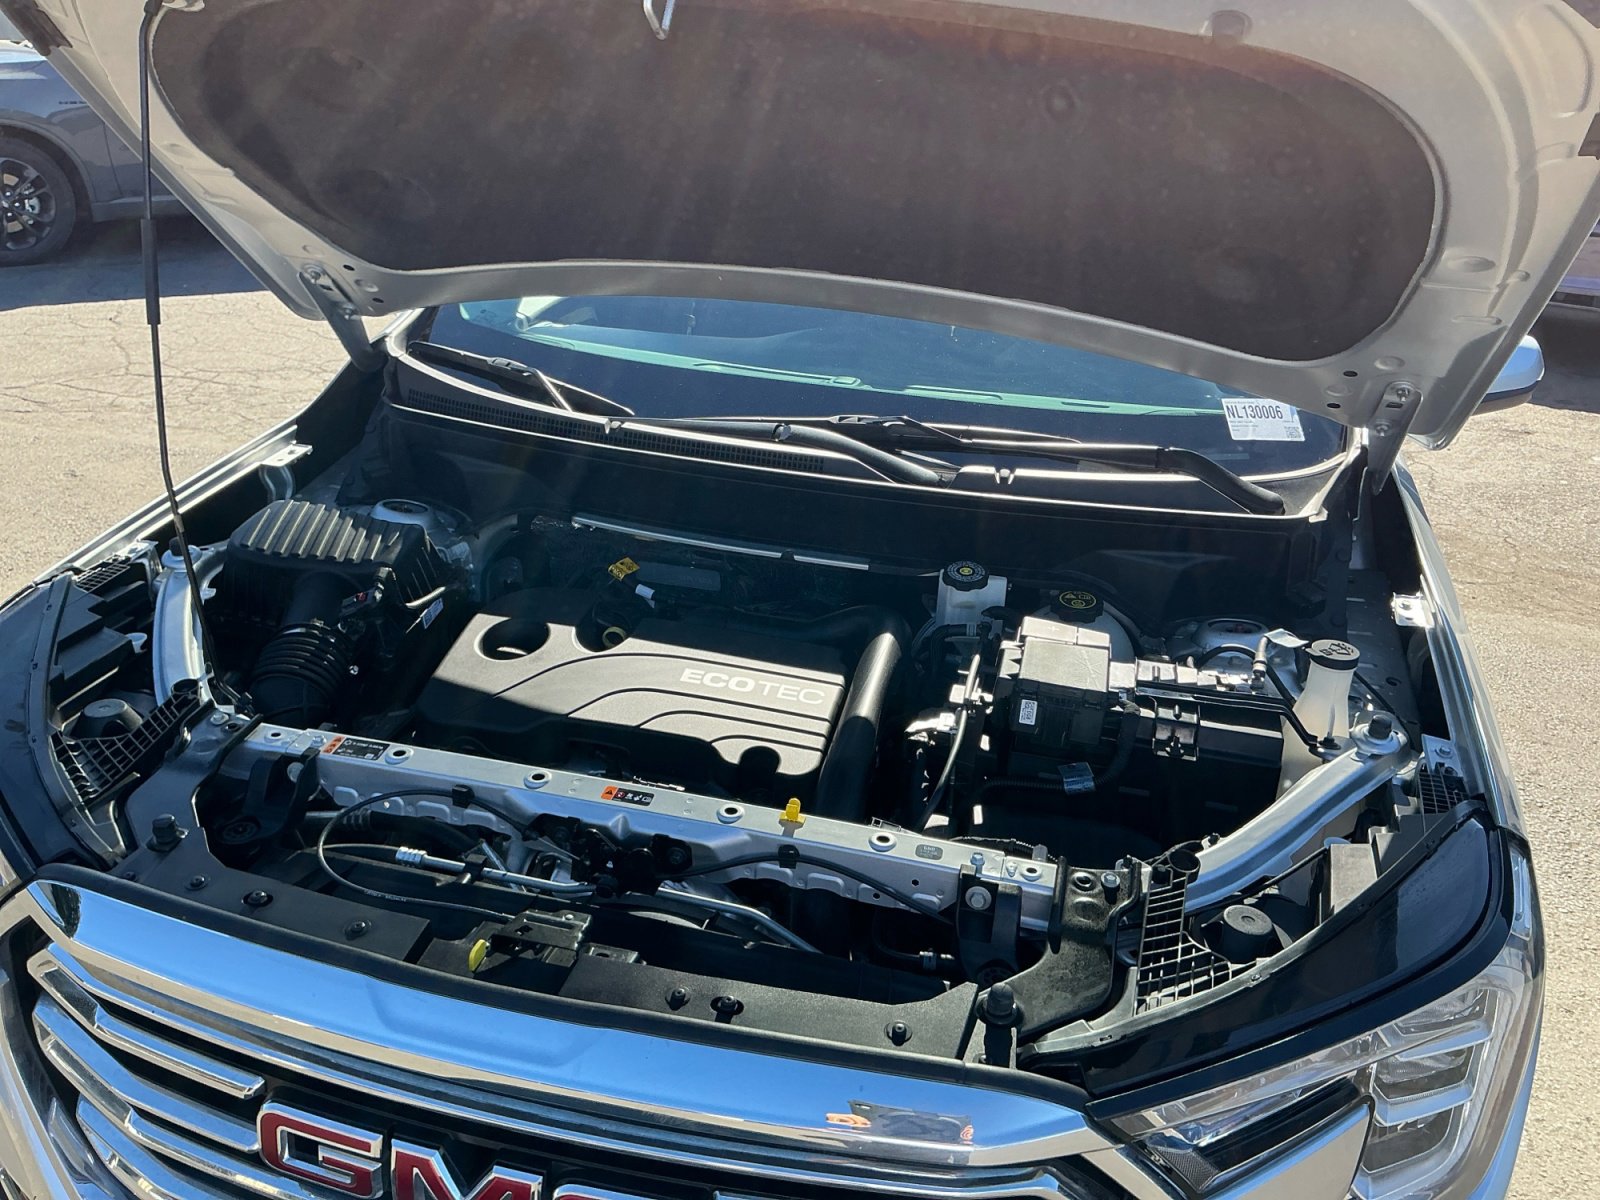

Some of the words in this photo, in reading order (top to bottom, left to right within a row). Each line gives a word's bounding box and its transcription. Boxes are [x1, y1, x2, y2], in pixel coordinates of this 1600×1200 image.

[1226, 405, 1283, 419] NL130006
[680, 668, 825, 704] ECOTEC
[256, 1100, 657, 1200] GM
